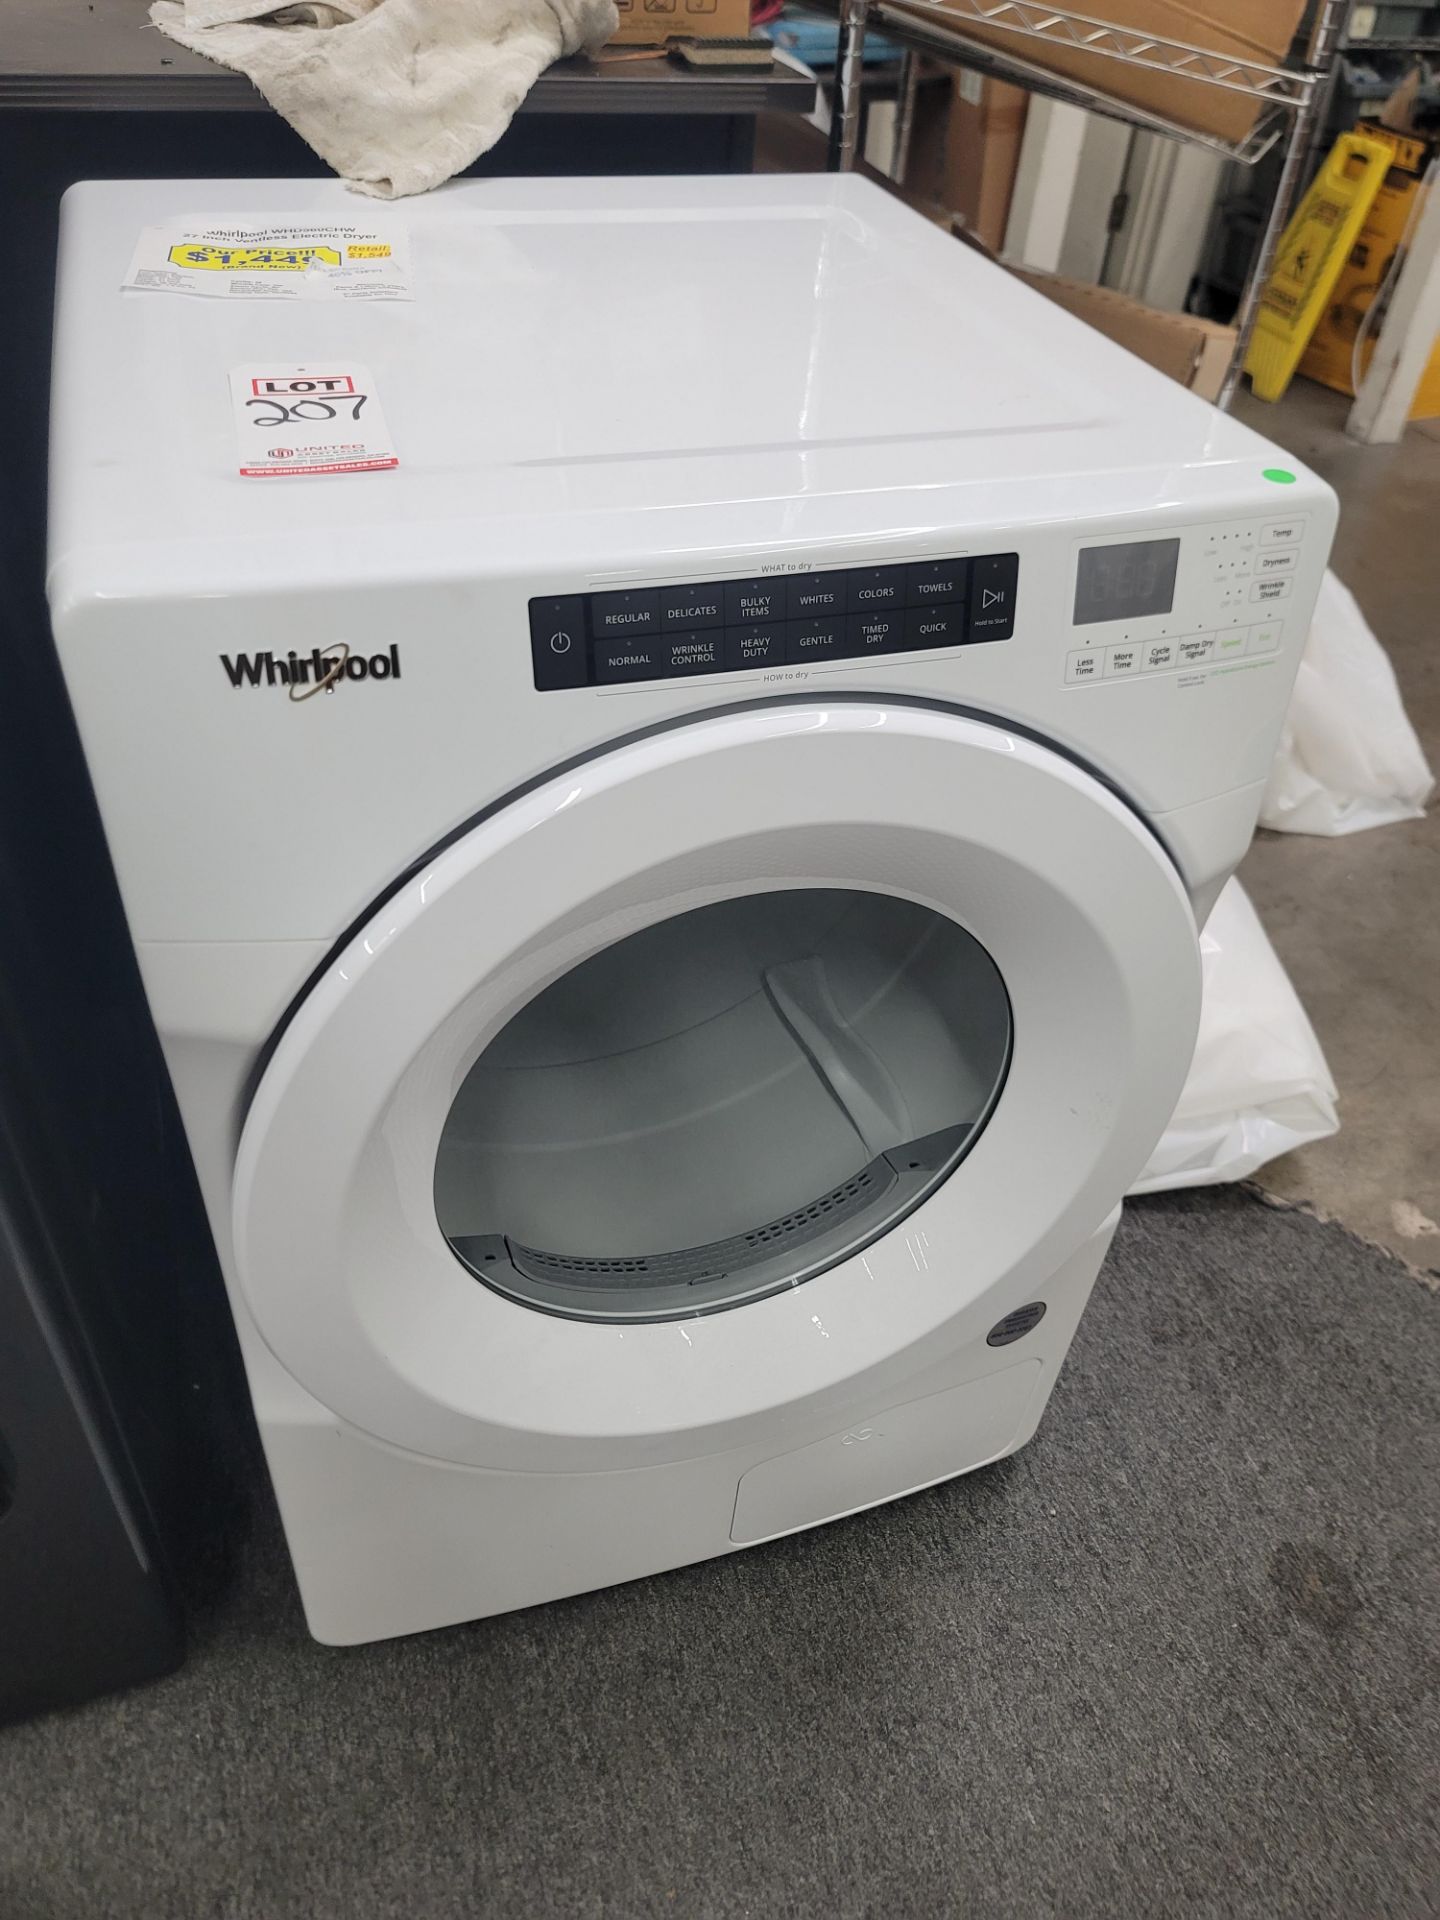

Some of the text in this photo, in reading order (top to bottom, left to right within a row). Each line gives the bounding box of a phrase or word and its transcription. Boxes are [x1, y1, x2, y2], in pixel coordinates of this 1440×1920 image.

[206, 230, 268, 239] Whirlpool
[265, 380, 341, 393] LOT
[246, 395, 368, 427] 207
[296, 444, 365, 452] UNITED
[1272, 529, 1293, 538] Temp
[761, 562, 812, 573] WHAT to dry
[1262, 557, 1291, 568] Dryness
[918, 582, 953, 594] TOWELS
[1258, 581, 1285, 591] Wrinkle
[858, 587, 895, 600] COLORS
[1259, 590, 1281, 599] Shield
[740, 596, 771, 608] BULKY
[800, 593, 834, 606] WHITES
[667, 605, 717, 619] DELICATES
[741, 606, 770, 617] ITEMS
[605, 612, 651, 625] REGULAR
[974, 619, 988, 627] Hold
[994, 617, 1008, 625] Start
[861, 624, 889, 635] TIMED
[919, 622, 948, 635] QUICK
[740, 637, 771, 648] HEAVY
[800, 634, 834, 647] GENTLE
[866, 634, 884, 644] DRY
[671, 642, 715, 656] WRINKLE
[1151, 646, 1170, 656] Cycle
[1179, 640, 1214, 652] Damp Dry
[743, 647, 769, 658] DUTY
[1113, 652, 1133, 662] More
[1185, 648, 1206, 660] Signal
[608, 654, 651, 667] NORMAL
[671, 652, 716, 666] CONTROL
[1077, 658, 1094, 667] Less
[1148, 654, 1170, 666] Signal
[219, 643, 401, 696] Whirlpool
[1113, 661, 1132, 670] Time
[763, 673, 784, 683] HOW
[795, 671, 810, 680] dry
[1075, 667, 1094, 676] Time
